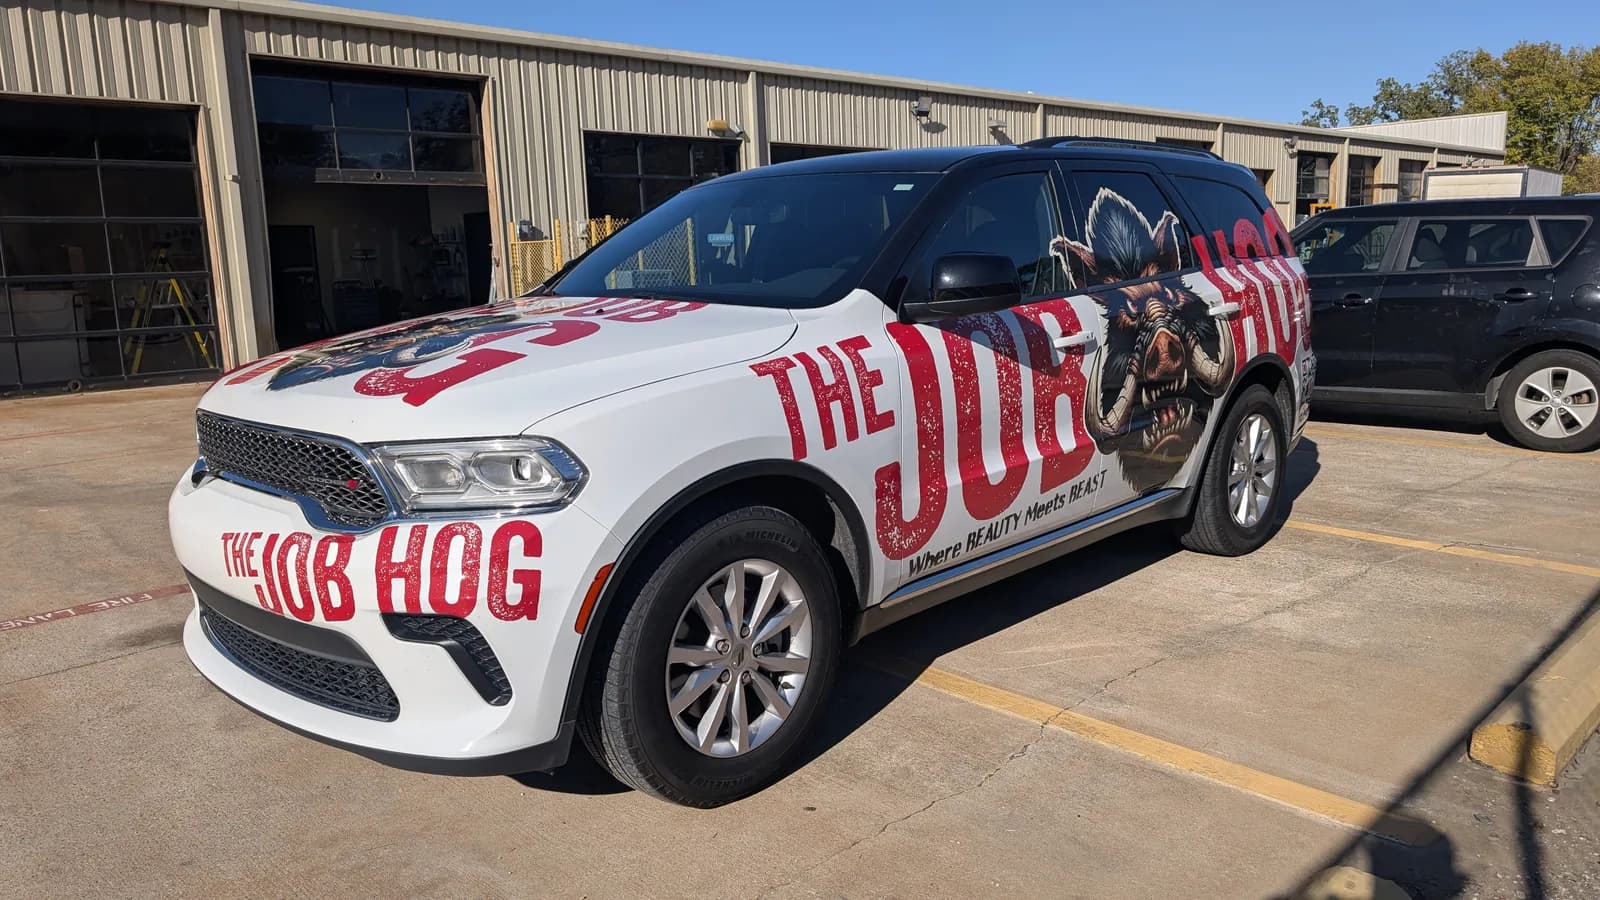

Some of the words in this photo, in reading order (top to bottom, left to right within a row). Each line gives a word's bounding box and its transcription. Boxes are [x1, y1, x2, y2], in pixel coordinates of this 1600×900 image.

[749, 335, 896, 461] THE
[875, 297, 1096, 561] JOB
[221, 531, 264, 577] THE
[254, 531, 357, 622] JOB
[375, 519, 543, 621] HOG
[908, 540, 963, 578] Where
[966, 509, 1023, 553] BEAUTY
[1024, 493, 1066, 525] Meets
[1068, 469, 1108, 505] BEAST
[0, 608, 77, 632] LANE
[88, 593, 153, 612] FIRE
